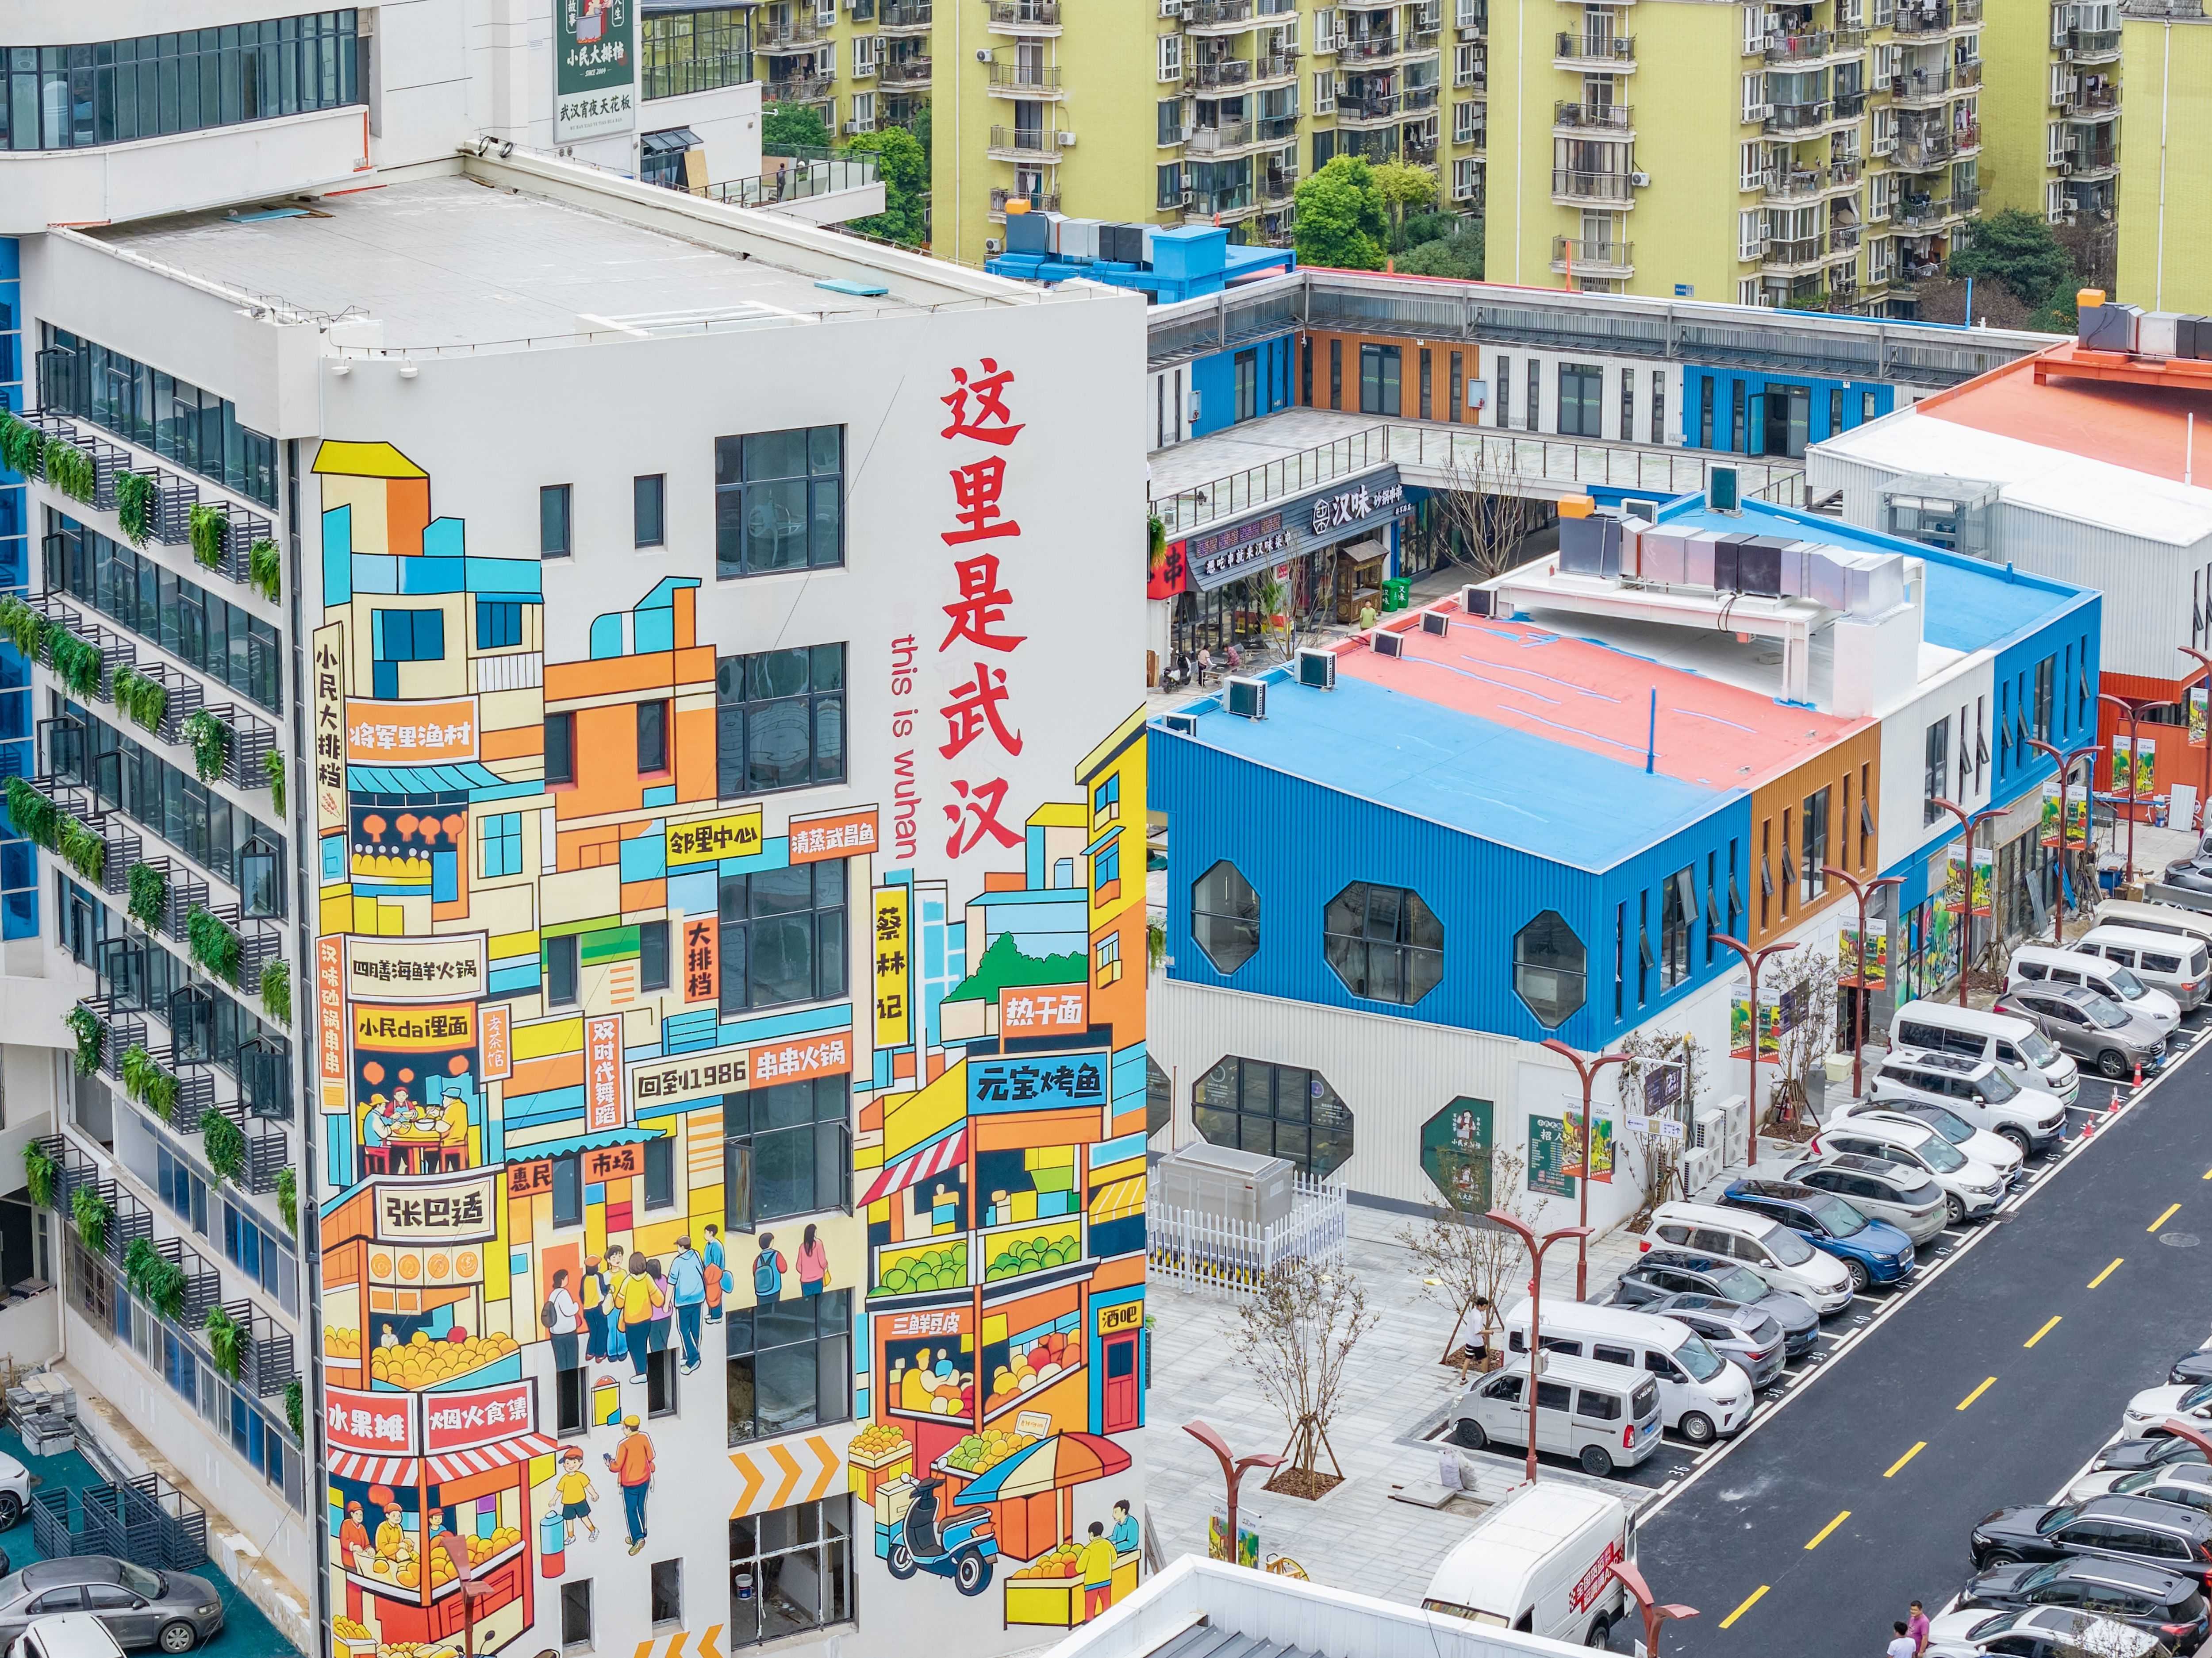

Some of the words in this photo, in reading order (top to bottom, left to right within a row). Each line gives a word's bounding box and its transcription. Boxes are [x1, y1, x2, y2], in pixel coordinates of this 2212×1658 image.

[567, 41, 624, 67] 小民大排档
[560, 94, 631, 122] 武汉宵夜天花板
[1333, 484, 1372, 526] 汉味
[1374, 484, 1403, 508] 砂锅串串
[939, 358, 1027, 858] 这里是武汉
[891, 634, 918, 696] this
[316, 643, 341, 789] 小民大排档
[892, 709, 919, 737] is
[349, 721, 471, 750] 将军里渔村
[894, 749, 922, 859] wuhan
[670, 825, 758, 855] 邻里中心
[791, 822, 876, 854] 清蒸武昌鱼
[353, 959, 477, 981] 四膳海鲜火锅
[687, 922, 712, 996] 大排档
[876, 907, 906, 1019] 蔡林记
[321, 943, 340, 1074] 汉味砂锅串串
[359, 1015, 468, 1039] 小民dai里面
[1006, 995, 1083, 1026] 热干面
[487, 1014, 505, 1067] 老茶馆
[757, 1039, 846, 1080] 串串火锅
[592, 1021, 616, 1126] 双时代舞蹈
[637, 1061, 747, 1099] 回到1986
[977, 1062, 1102, 1101] 元宝烤鱼
[510, 1164, 553, 1192] 惠民
[592, 1150, 635, 1177] 市场
[387, 1191, 484, 1227] 张巴适
[891, 1312, 960, 1335] 三鲜豆皮
[1102, 1305, 1137, 1328] 酒吧
[1852, 1315, 1872, 1325] 40
[328, 1403, 405, 1442] 水果摊
[1668, 1466, 1690, 1477] 36
